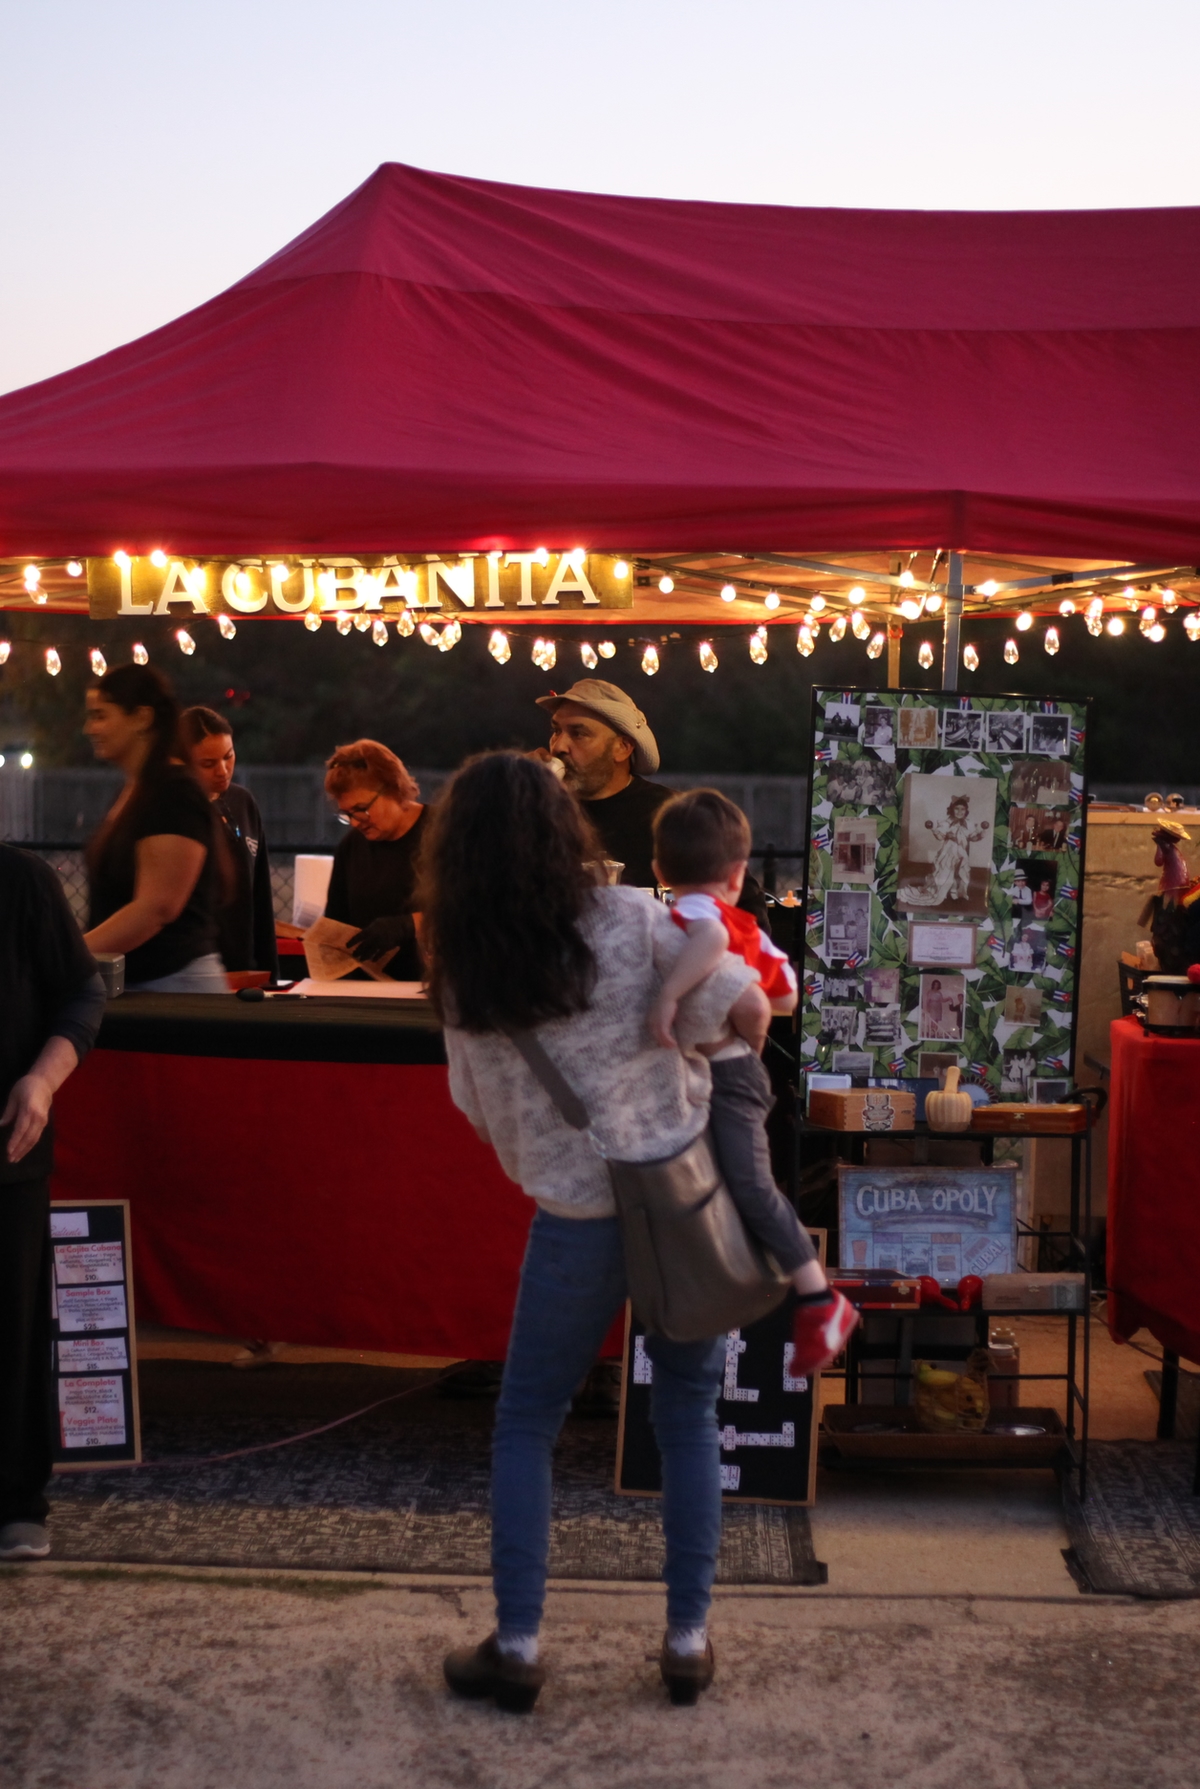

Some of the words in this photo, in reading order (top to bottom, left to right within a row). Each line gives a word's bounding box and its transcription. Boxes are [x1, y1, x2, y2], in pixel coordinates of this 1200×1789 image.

[117, 556, 211, 616] LA
[221, 552, 602, 614] CUBANITA
[856, 1185, 923, 1216] CUBA
[932, 1185, 998, 1216] OPOLY
[55, 1246, 65, 1254] La
[91, 1244, 121, 1252] Cubana
[969, 1238, 1007, 1276] CUBA!
[65, 1288, 94, 1298] Sample
[96, 1288, 111, 1296] Box
[76, 1378, 116, 1388] Completa
[84, 1406, 100, 1414] $12.
[66, 1417, 95, 1427] Veggie
[97, 1415, 119, 1424] Plate
[86, 1437, 102, 1446] $10.
